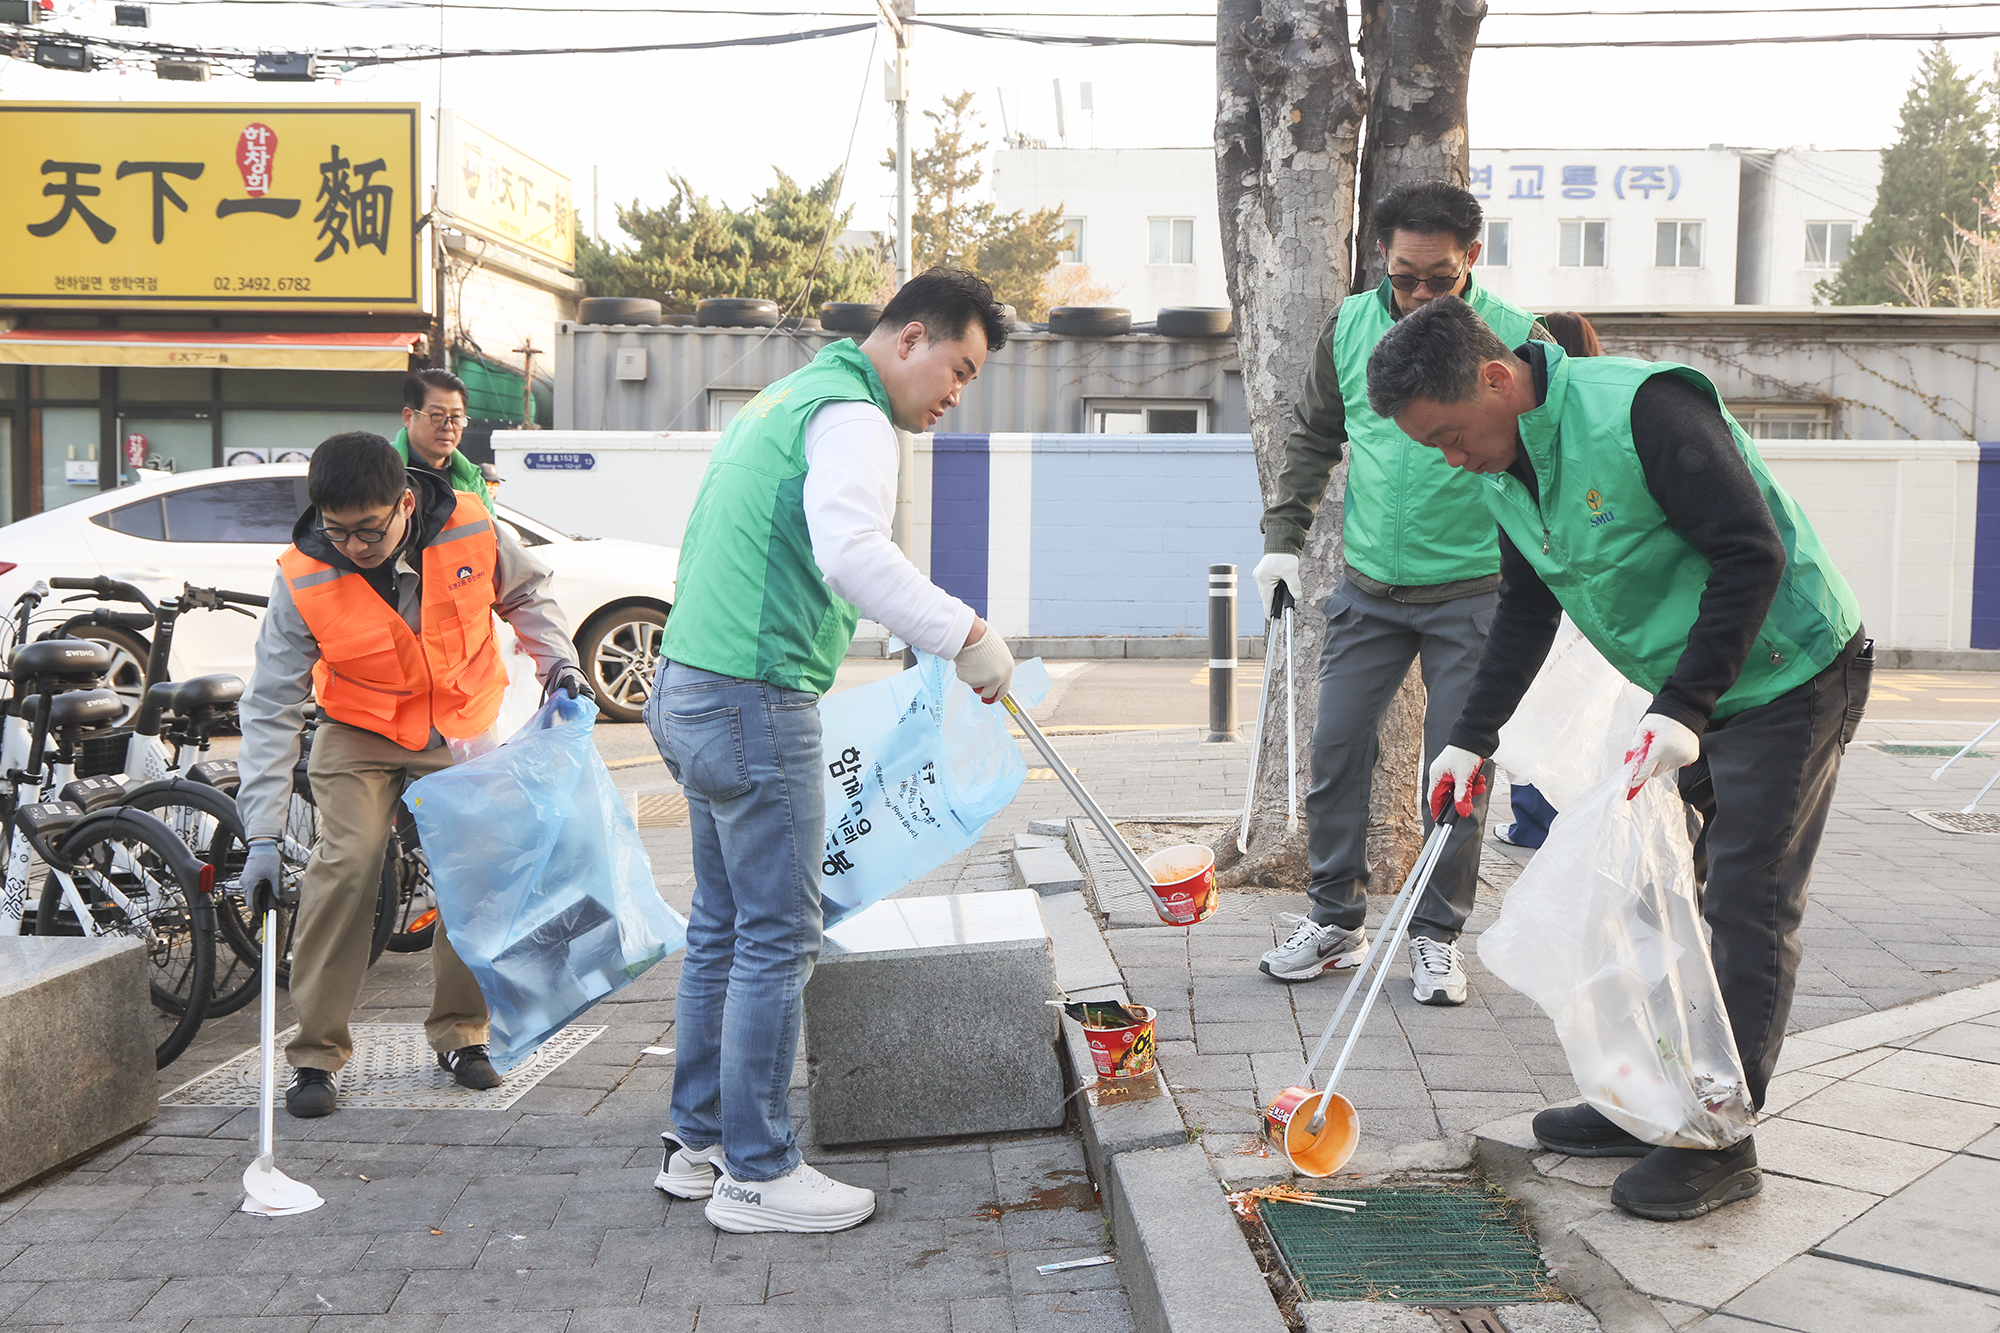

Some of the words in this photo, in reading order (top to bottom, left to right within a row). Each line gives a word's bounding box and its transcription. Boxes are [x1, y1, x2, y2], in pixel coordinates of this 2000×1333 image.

[243, 126, 271, 194] 한창희
[54, 276, 103, 291] 천하일면
[109, 277, 158, 292] 방학역점
[213, 276, 311, 292] 02.3492.6782
[1589, 511, 1615, 528] SMU
[65, 650, 96, 658] SWING
[220, 680, 241, 690] SWING
[86, 697, 112, 708] SWING
[717, 1182, 762, 1206] HOKA
